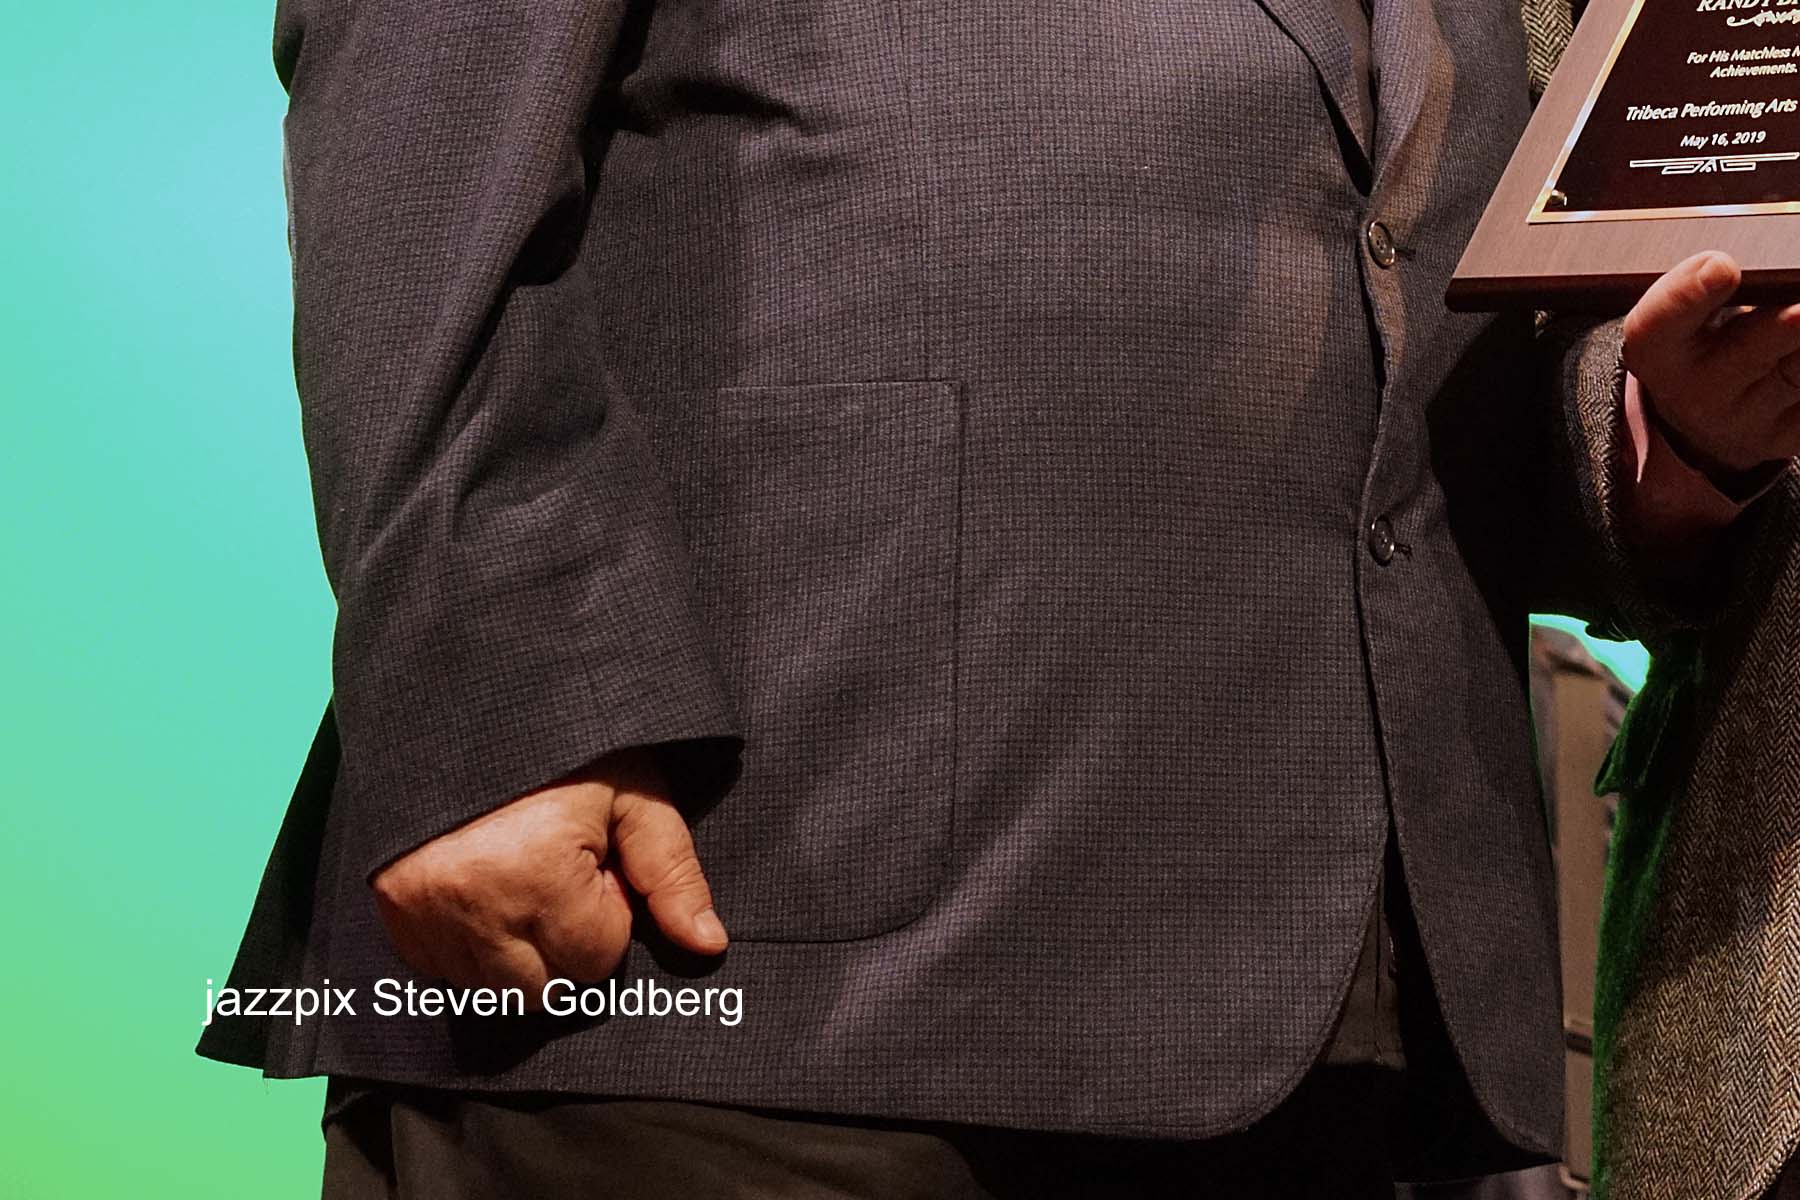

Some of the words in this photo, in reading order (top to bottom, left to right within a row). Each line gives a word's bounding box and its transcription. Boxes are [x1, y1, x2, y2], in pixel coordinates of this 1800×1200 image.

[1687, 52, 1708, 64] For
[1709, 50, 1730, 62] His
[1730, 46, 1791, 61] Matchless
[1710, 62, 1797, 78] Achievements.
[1626, 105, 1678, 120] Tribeca
[1681, 100, 1765, 118] Performing
[1765, 98, 1798, 113] Arts
[1680, 135, 1709, 149] May
[1712, 133, 1728, 146] 16,
[1732, 131, 1766, 144] 2019
